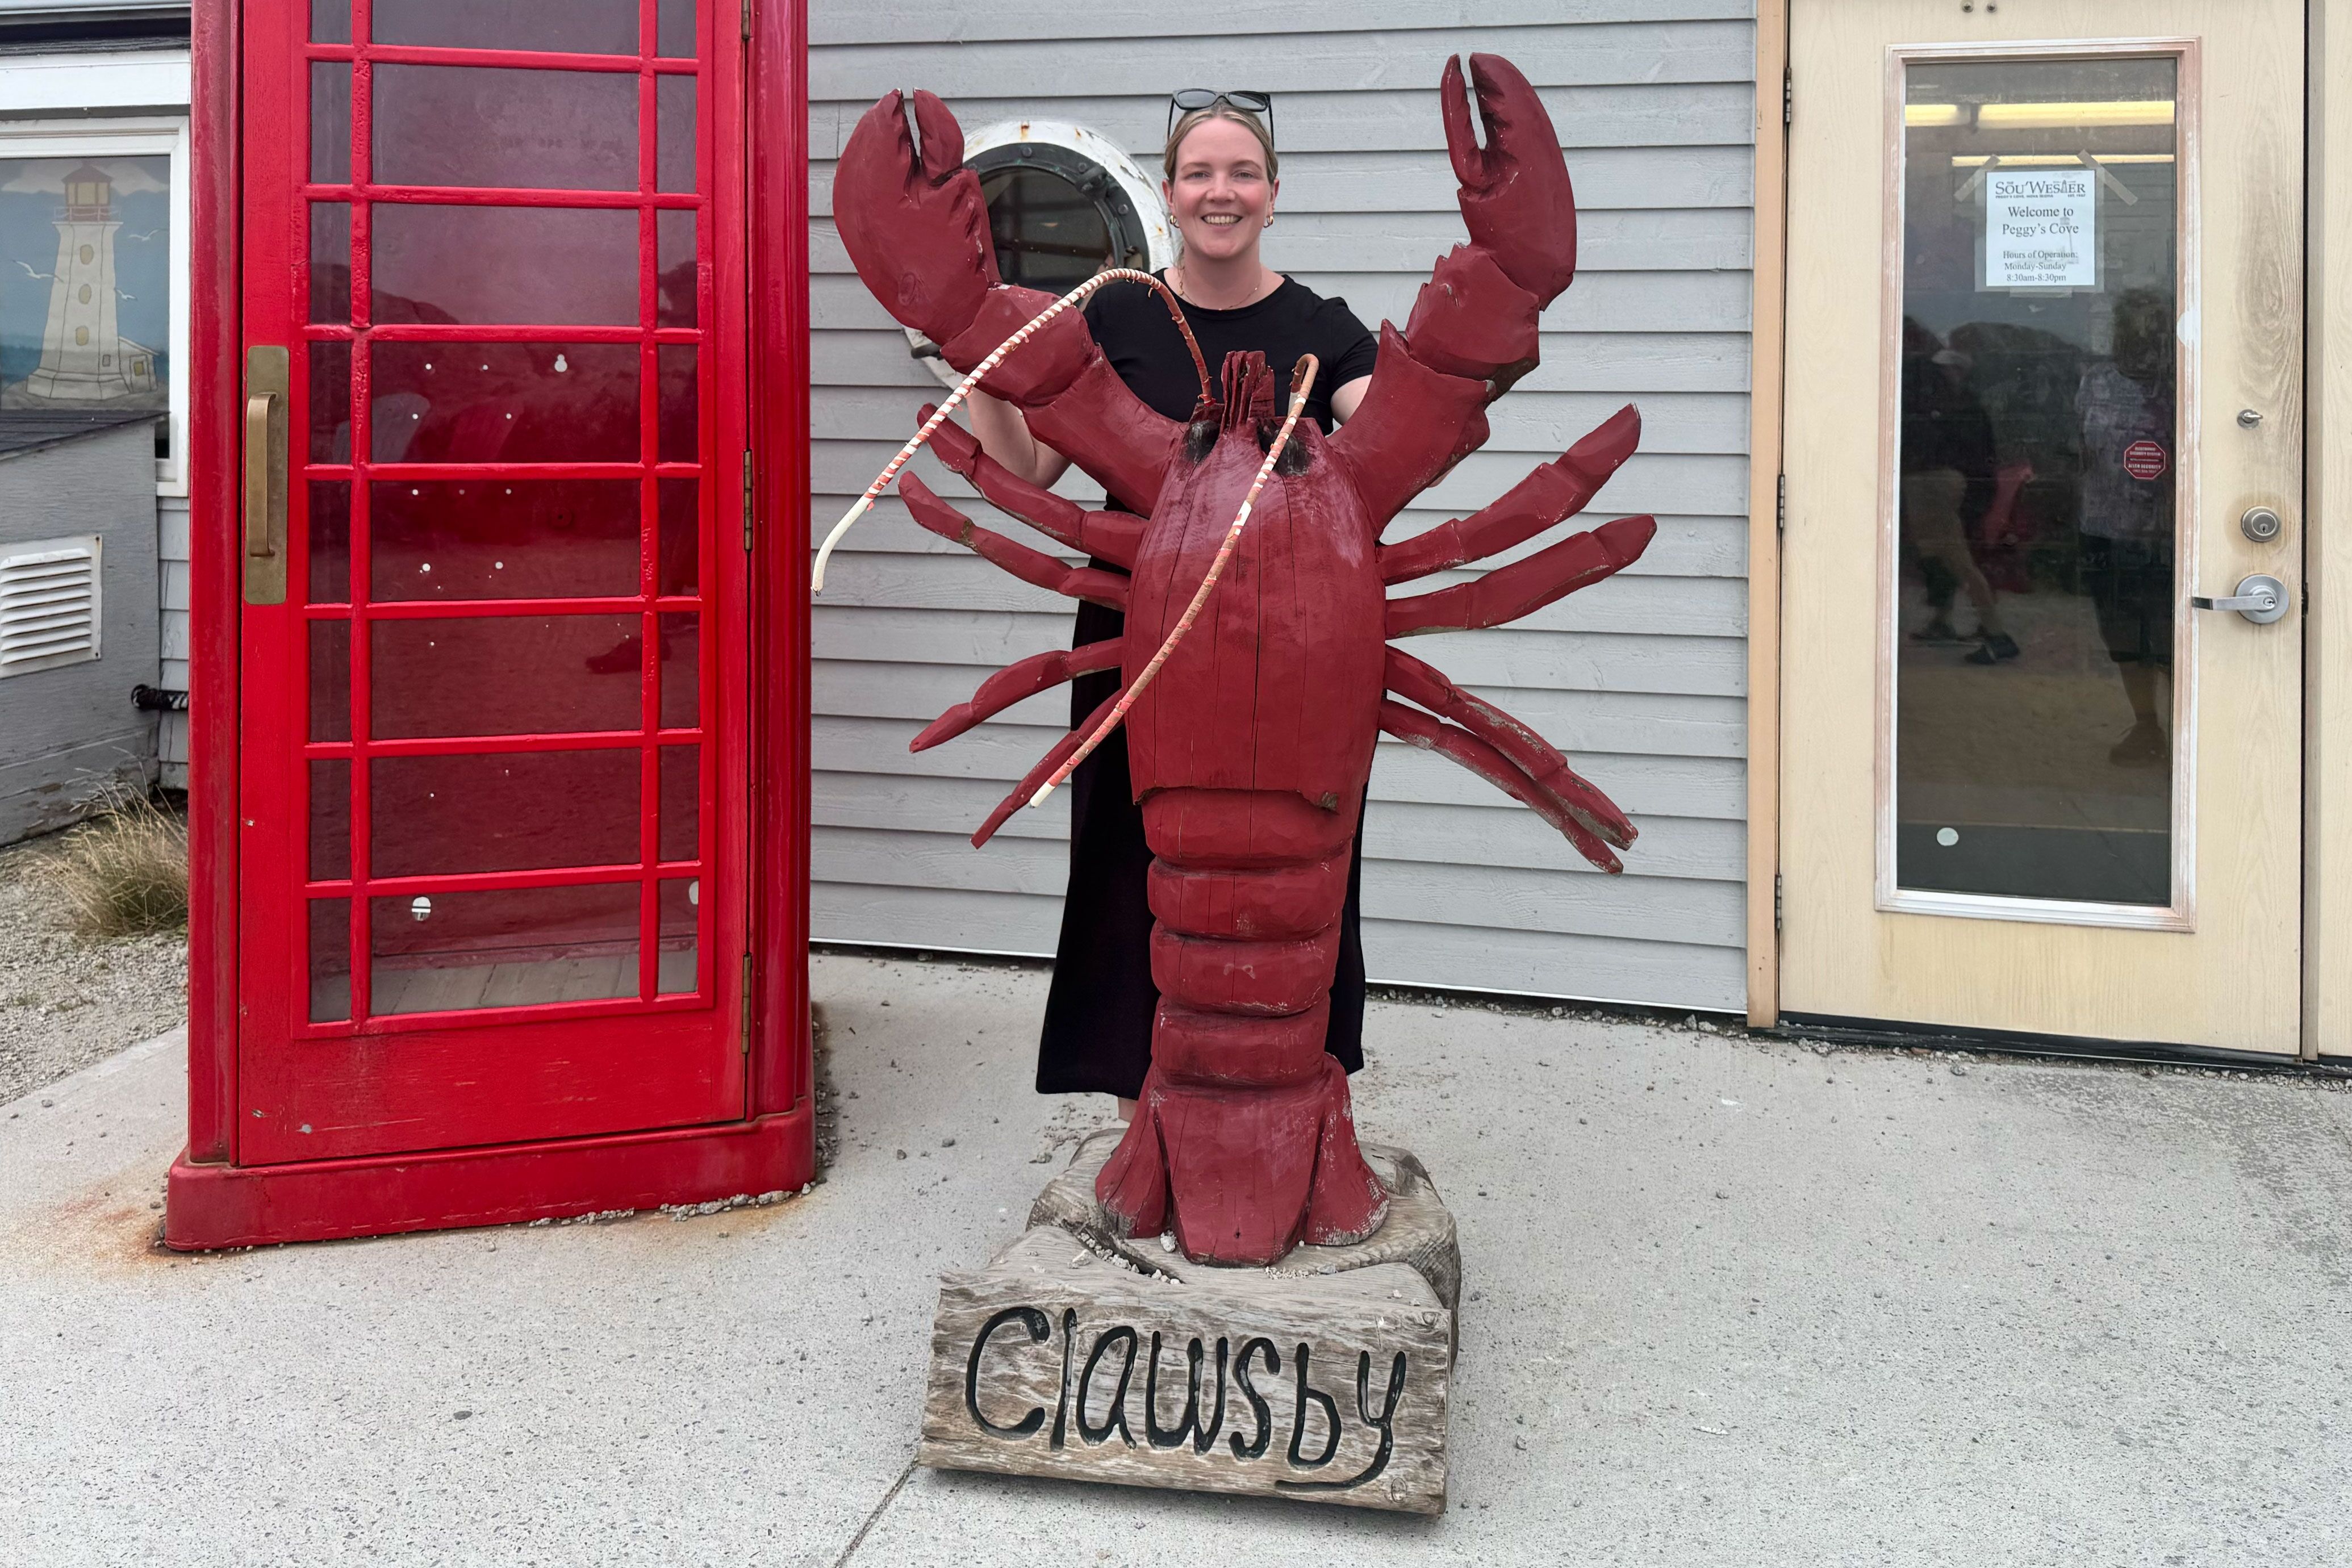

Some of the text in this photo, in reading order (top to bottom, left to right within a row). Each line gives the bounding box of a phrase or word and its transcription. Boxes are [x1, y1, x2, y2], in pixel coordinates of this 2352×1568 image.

[2008, 206, 2074, 218] Welcome to
[2002, 223, 2079, 237] Peggy's Cove
[2003, 250, 2026, 259] Hours
[2028, 250, 2037, 259] of
[2004, 262, 2066, 271] Monday-Sunday
[2007, 273, 2066, 283] 8:30am-8:30pm
[966, 1306, 1407, 1492] Clawsby
